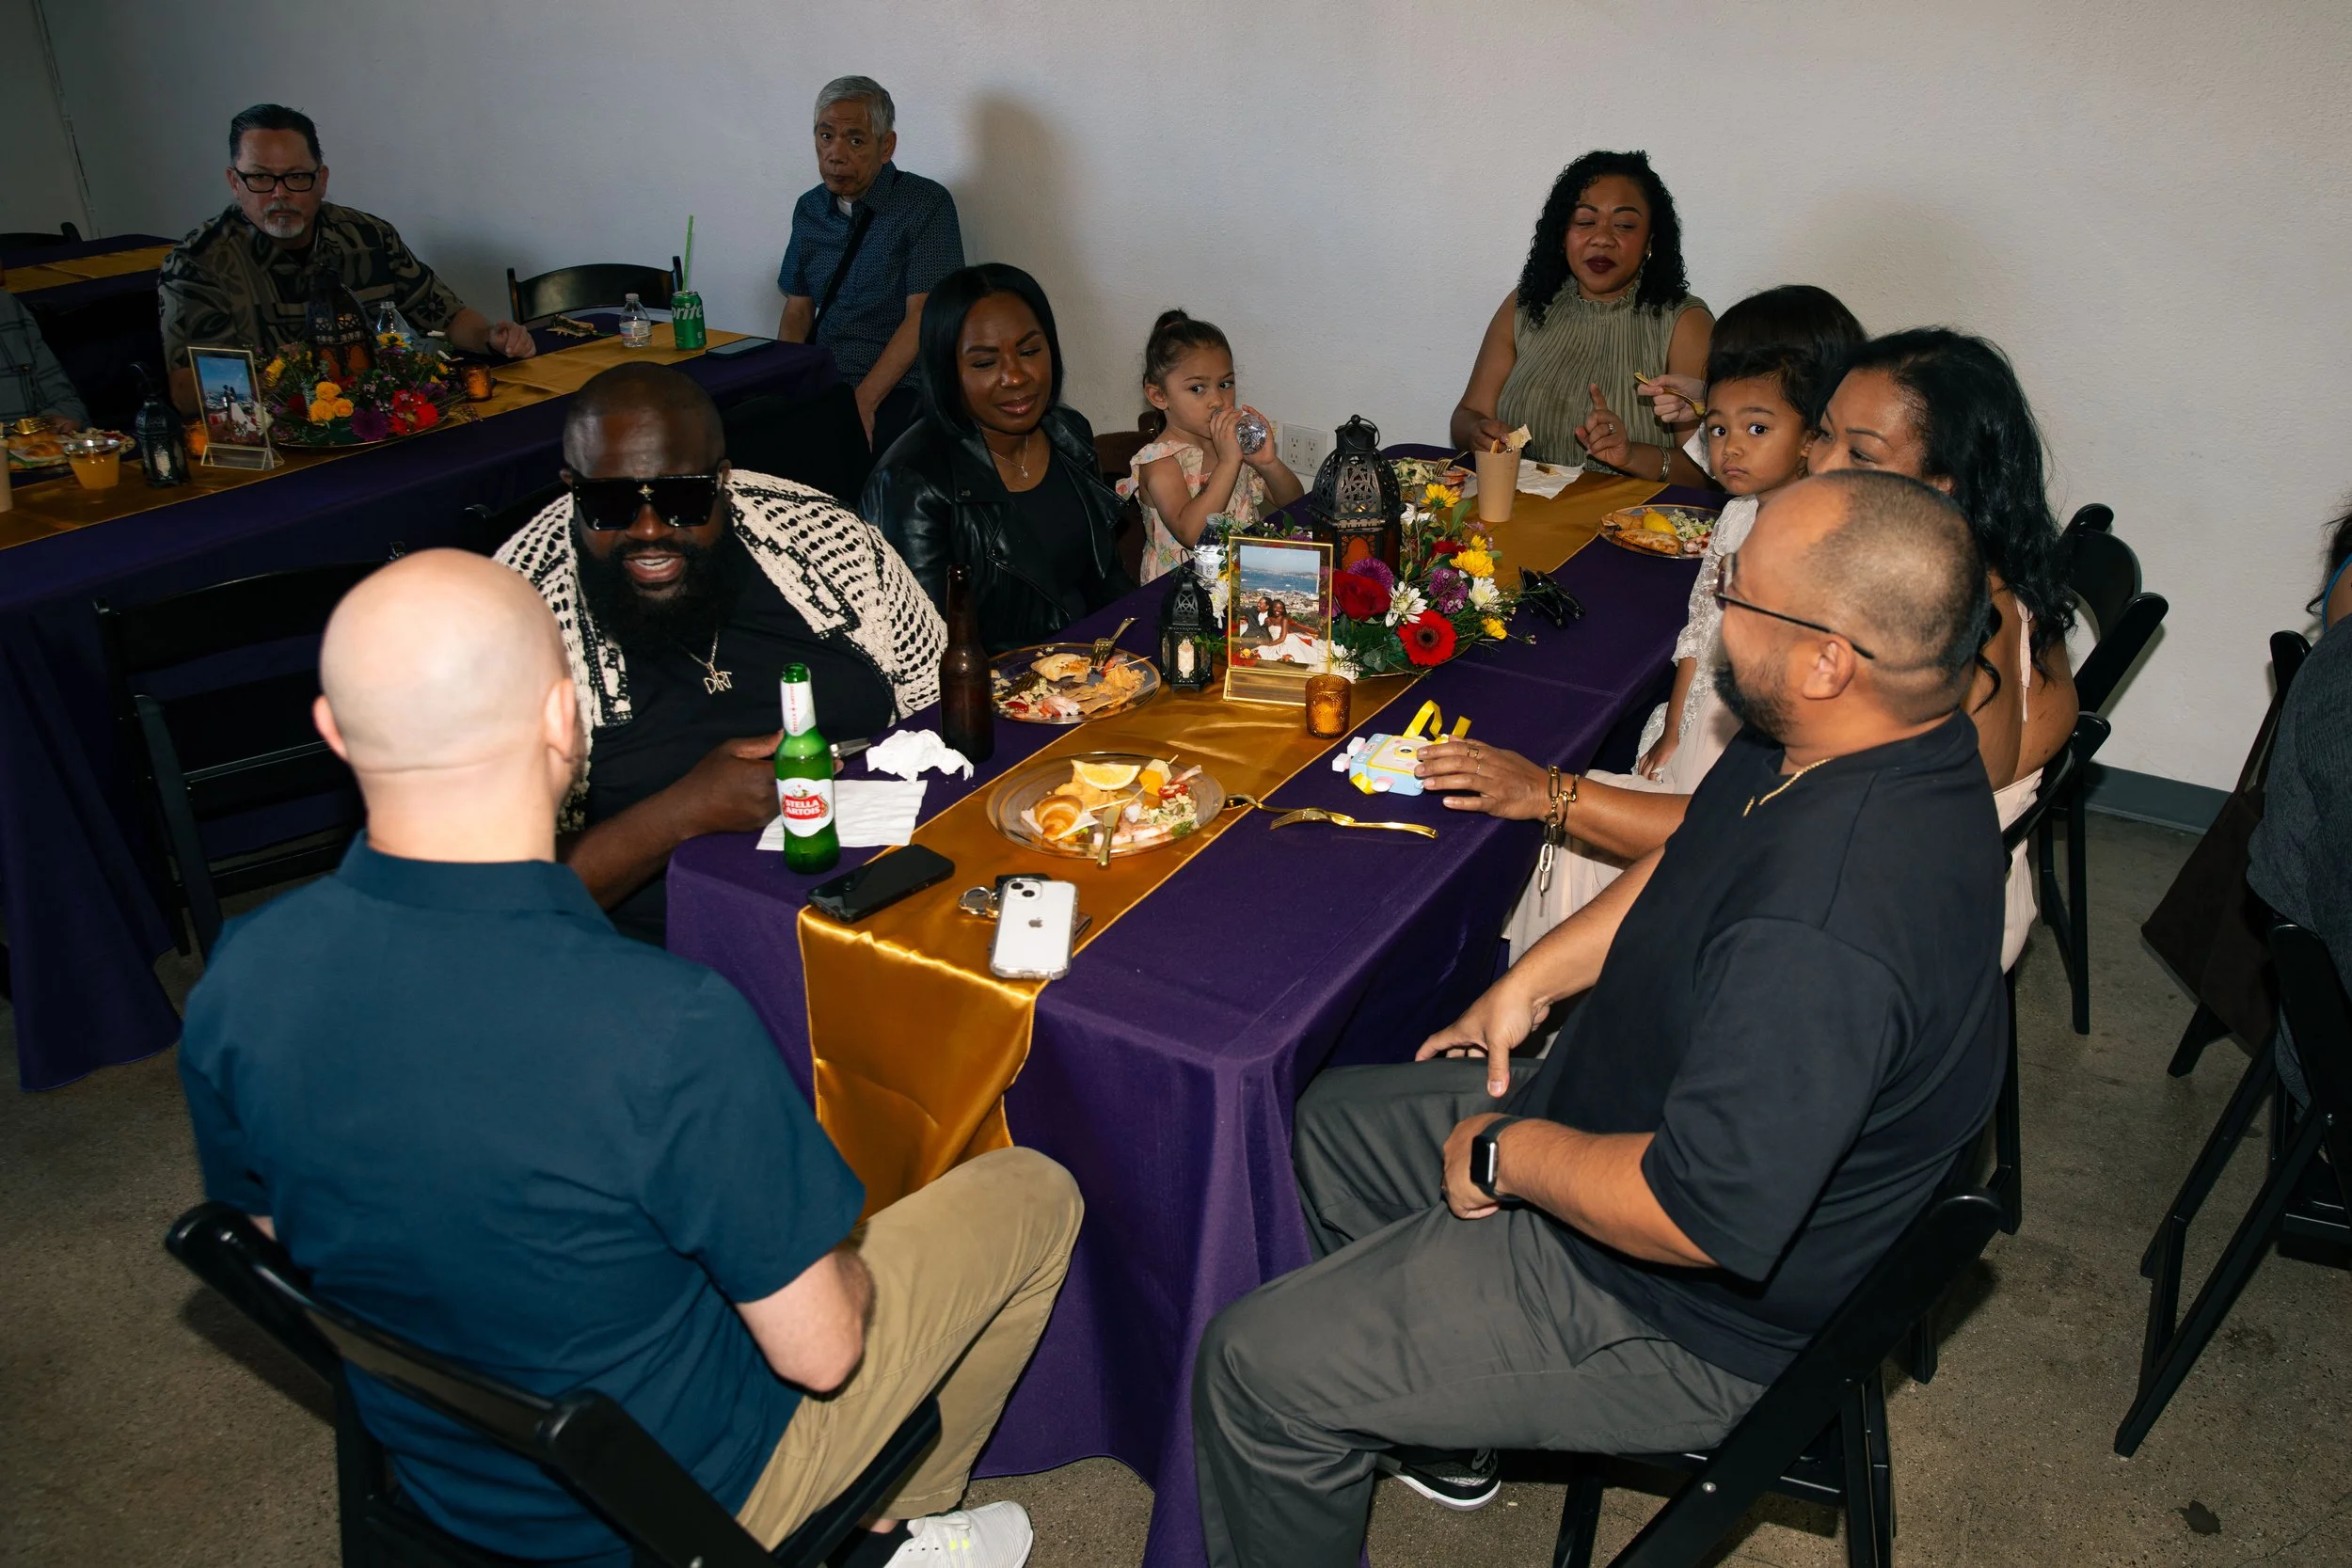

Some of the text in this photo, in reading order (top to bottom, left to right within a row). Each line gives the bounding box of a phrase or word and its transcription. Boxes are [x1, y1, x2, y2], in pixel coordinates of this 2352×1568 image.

[671, 302, 702, 320] rite
[703, 671, 733, 695] DIRT
[785, 799, 819, 808] STELLA
[786, 807, 820, 816] ARTOIS
